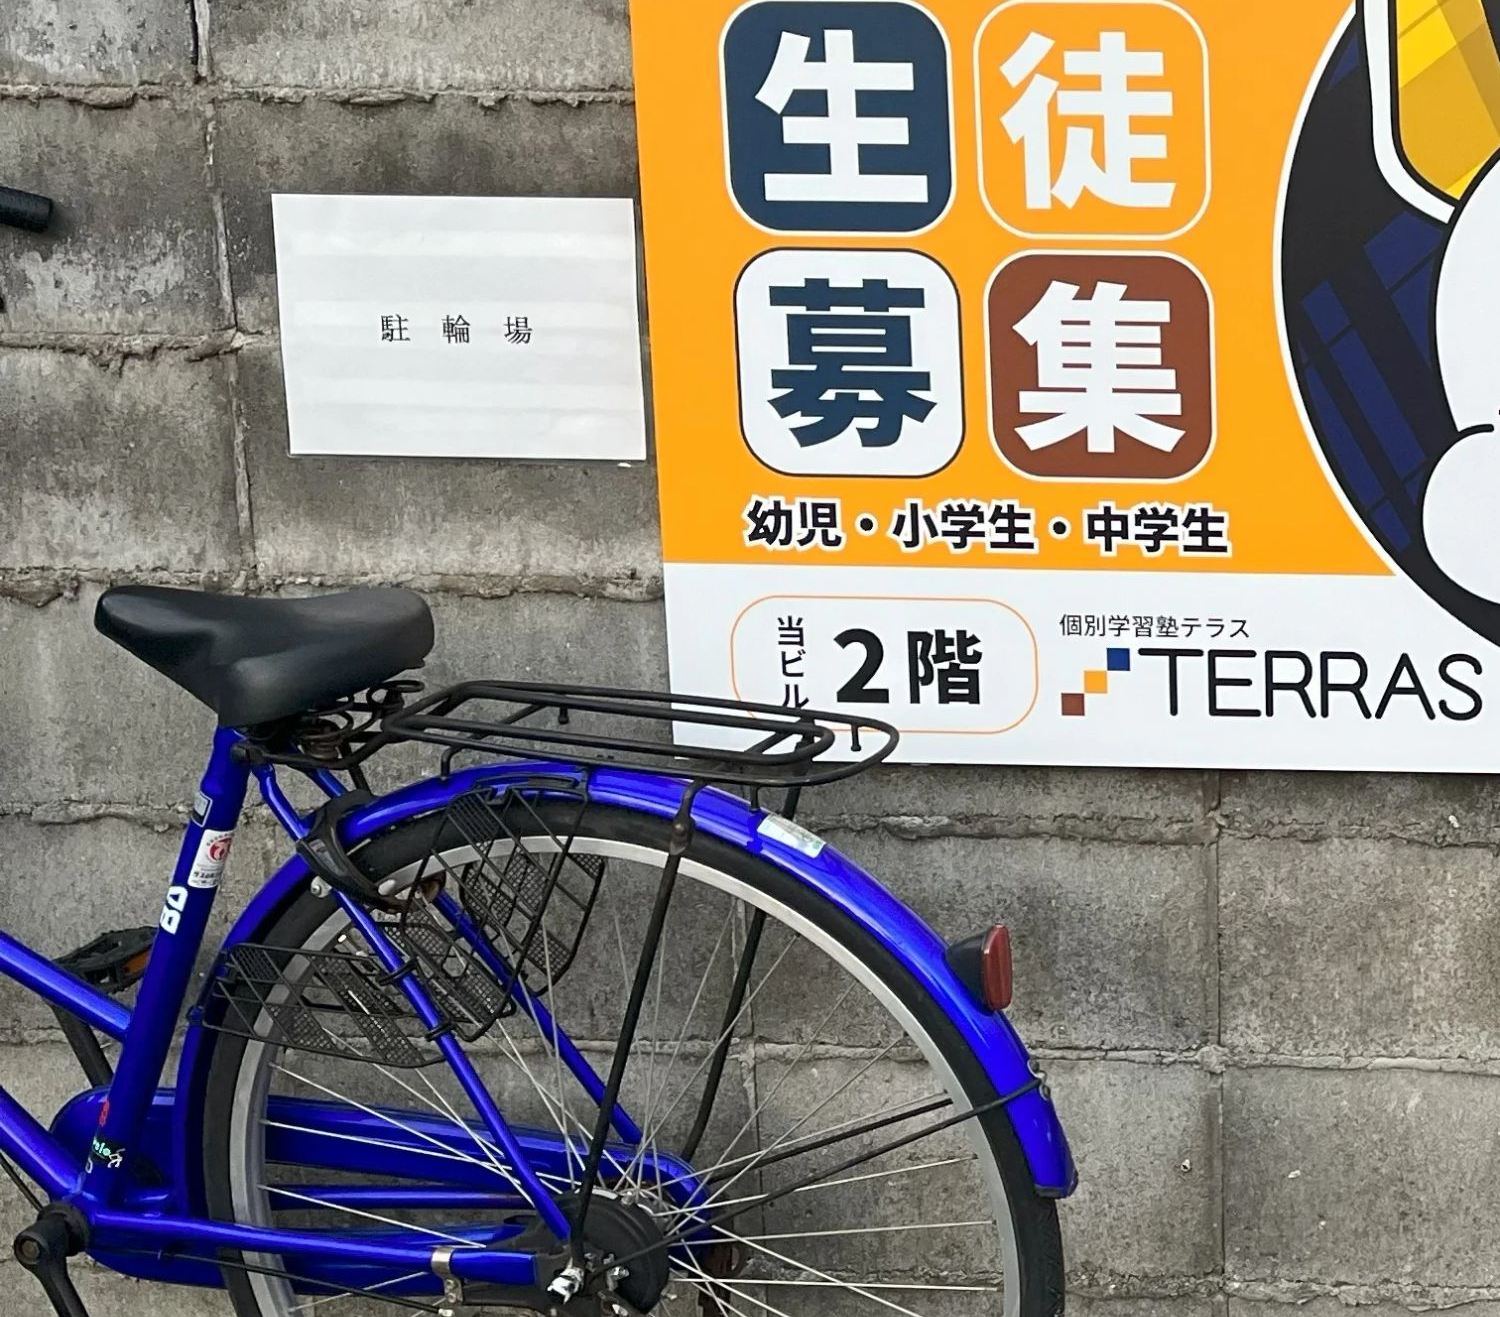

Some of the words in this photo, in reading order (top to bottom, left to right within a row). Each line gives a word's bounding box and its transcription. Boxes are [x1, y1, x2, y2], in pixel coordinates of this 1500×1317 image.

[754, 29, 1178, 210] 生徒
[379, 313, 534, 345] 駐輪場
[766, 277, 1187, 454] 募集
[744, 499, 1232, 557] 幼児・小学生・中学生
[1059, 614, 1250, 639] 個別学習塾テラス
[833, 628, 983, 705] 2階
[1138, 648, 1483, 721] TERRAS
